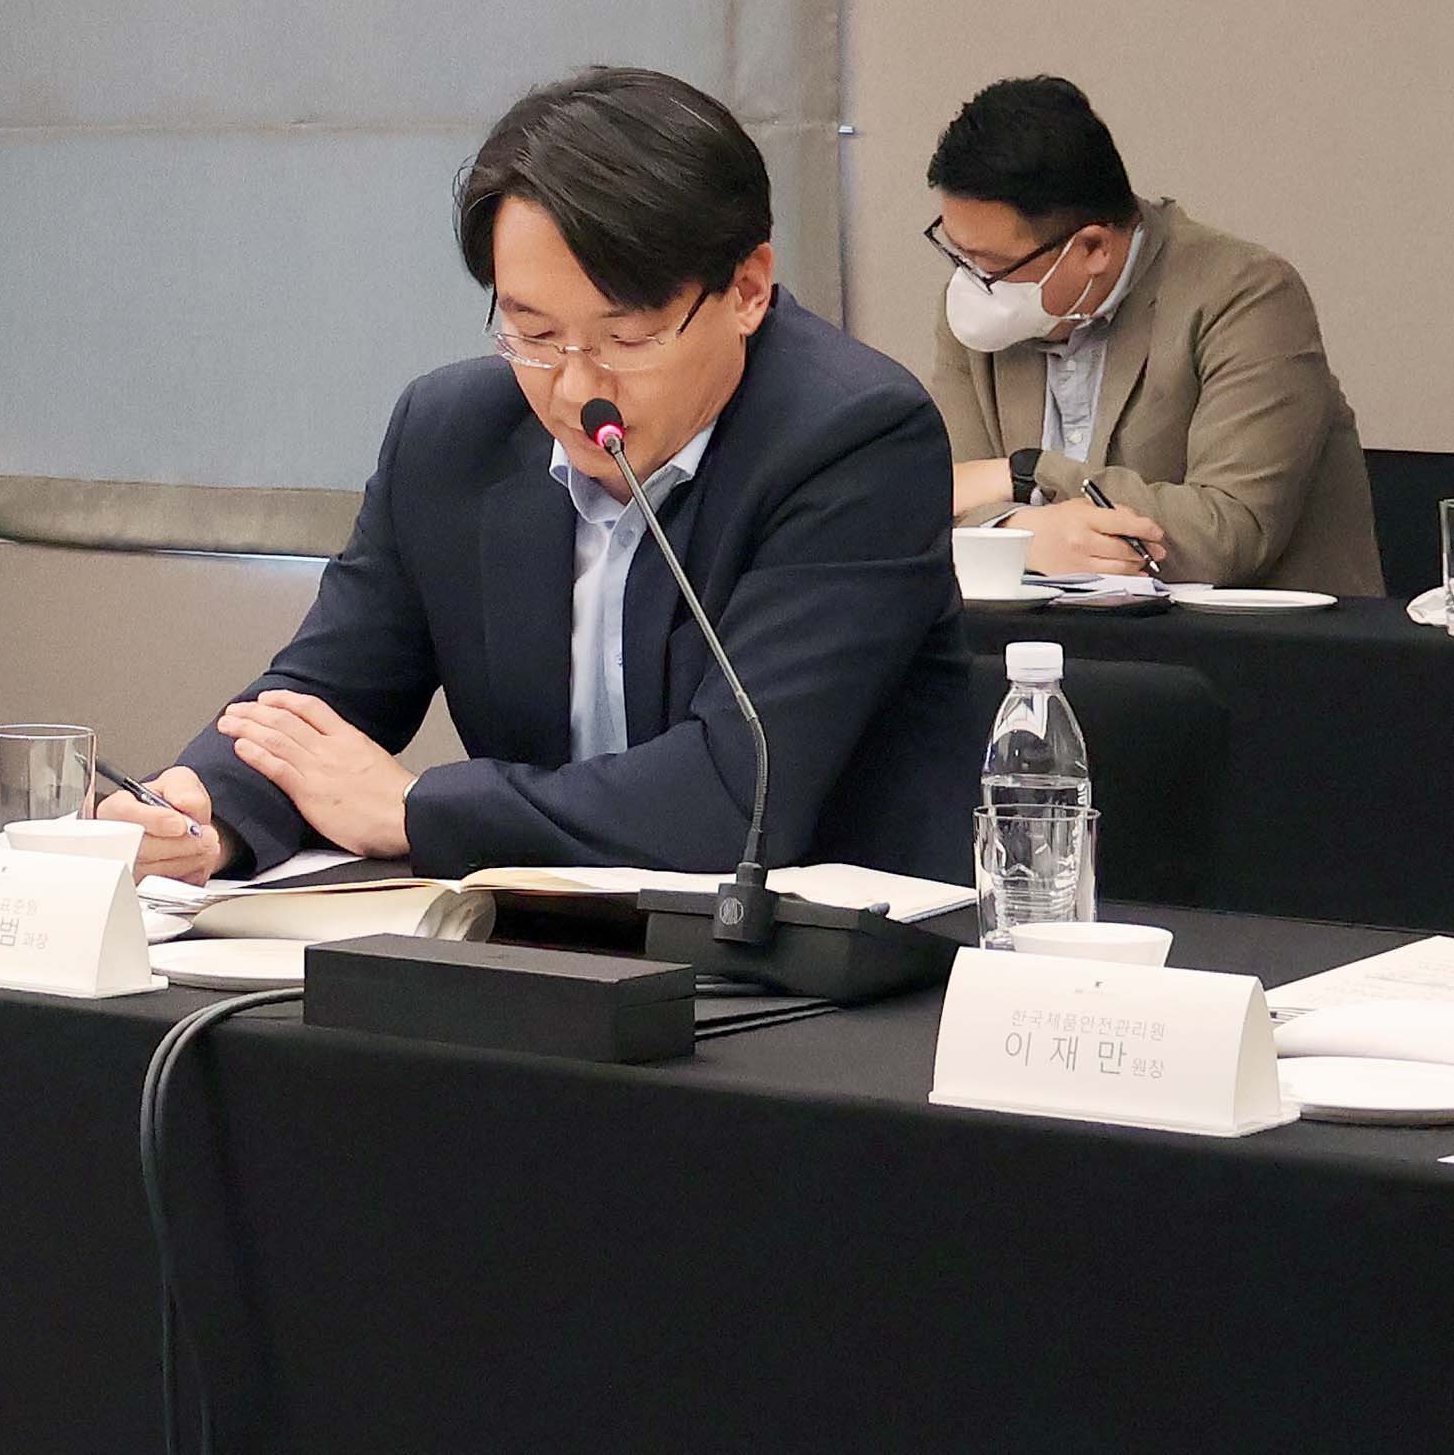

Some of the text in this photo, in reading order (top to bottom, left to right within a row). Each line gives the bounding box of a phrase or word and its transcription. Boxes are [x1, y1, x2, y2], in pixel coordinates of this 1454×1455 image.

[1011, 1009, 1167, 1042] 한국제품안전관리원
[1005, 1031, 1164, 1079] 이 재 만 원장
